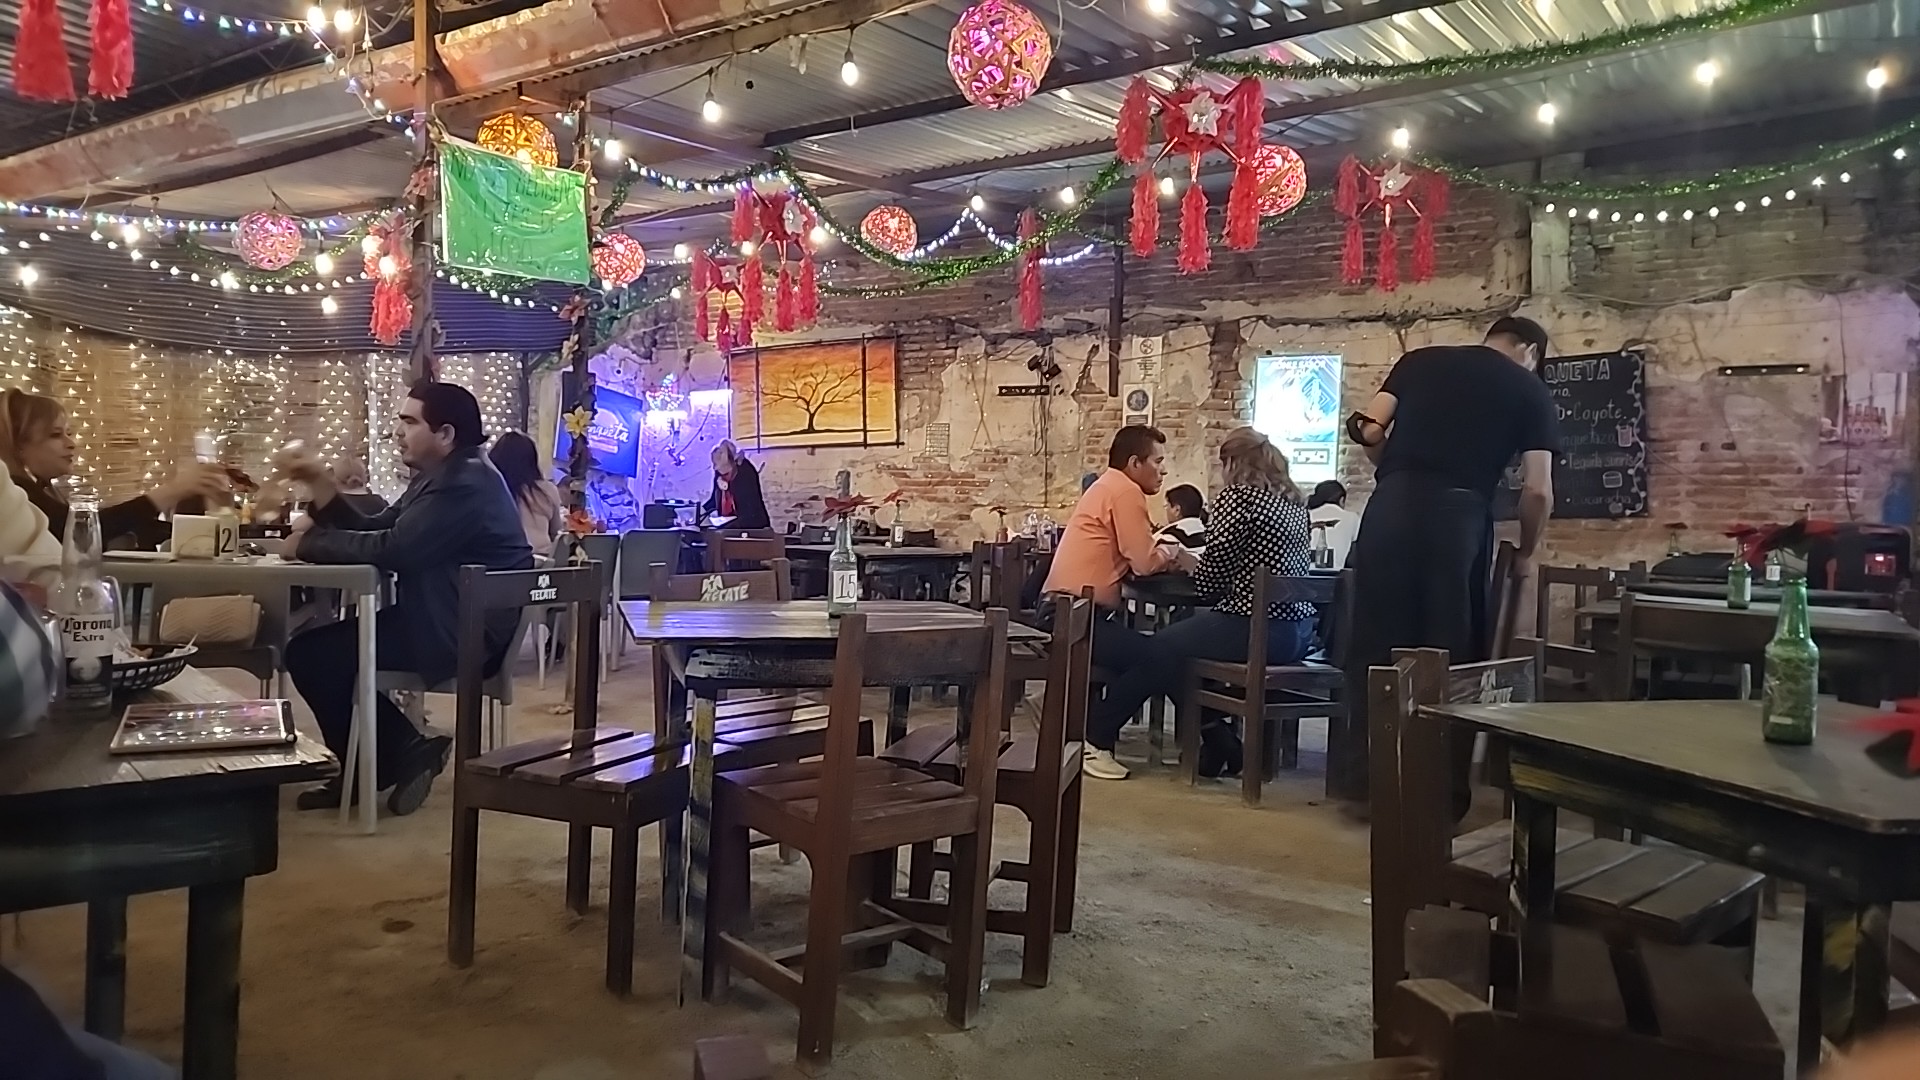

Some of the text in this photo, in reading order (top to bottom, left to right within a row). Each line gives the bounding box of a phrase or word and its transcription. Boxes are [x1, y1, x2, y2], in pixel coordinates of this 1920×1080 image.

[529, 587, 558, 601] TECATE
[835, 573, 856, 599] 15
[60, 617, 113, 635] Corona
[73, 632, 105, 642] Extra
